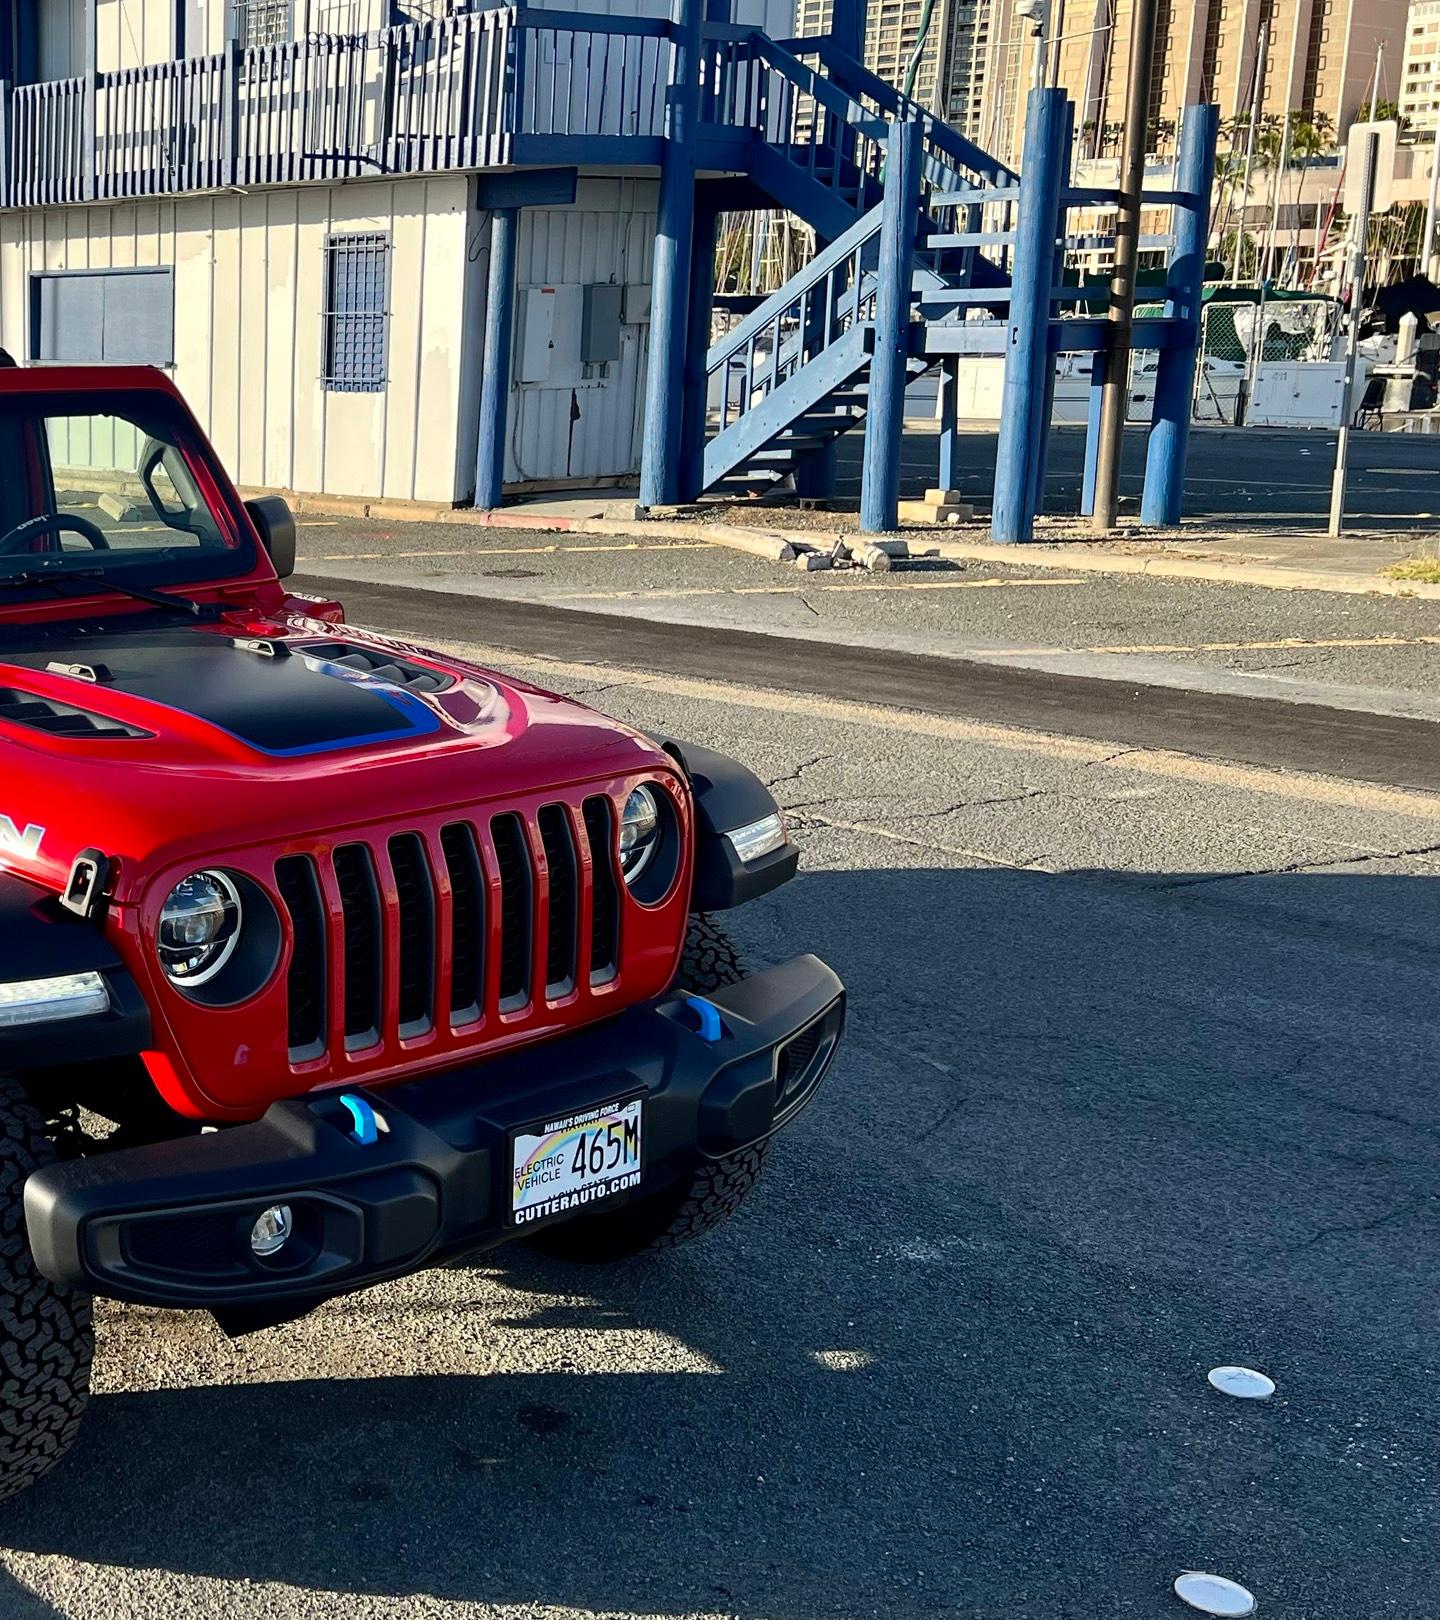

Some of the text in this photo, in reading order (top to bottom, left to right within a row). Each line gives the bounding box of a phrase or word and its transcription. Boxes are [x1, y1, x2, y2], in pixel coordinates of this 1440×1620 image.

[16, 513, 50, 531] Jeep
[574, 1110, 600, 1125] DRIVING
[600, 1103, 619, 1117] FORCE
[571, 1115, 639, 1179] 465M
[515, 1153, 564, 1178] ELECTRIC
[517, 1168, 561, 1190] VEHICLE
[515, 1172, 640, 1224] CUTTERAUTO.COM
